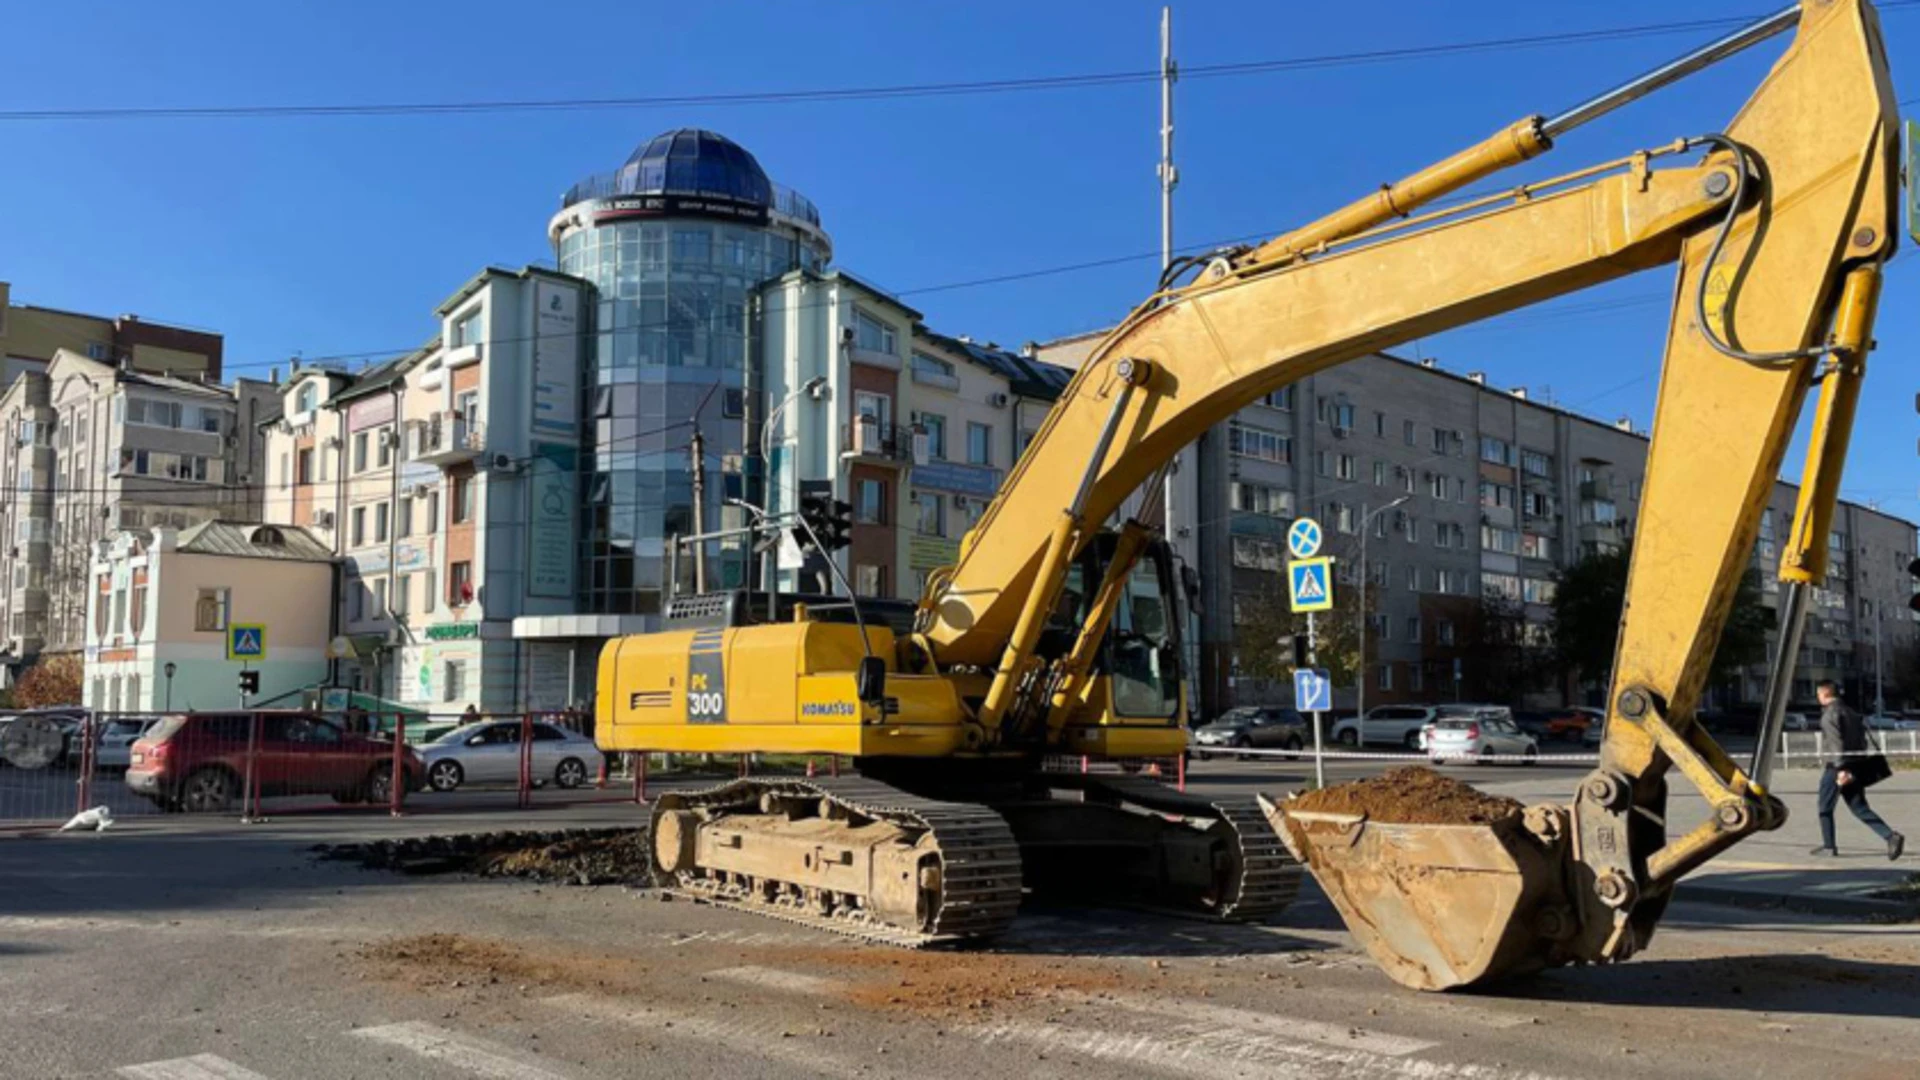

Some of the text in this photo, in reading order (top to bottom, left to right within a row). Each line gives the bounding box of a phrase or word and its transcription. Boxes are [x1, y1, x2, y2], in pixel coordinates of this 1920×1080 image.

[691, 674, 708, 691] PC
[688, 692, 723, 716] 300
[802, 700, 855, 716] KOMATSU
